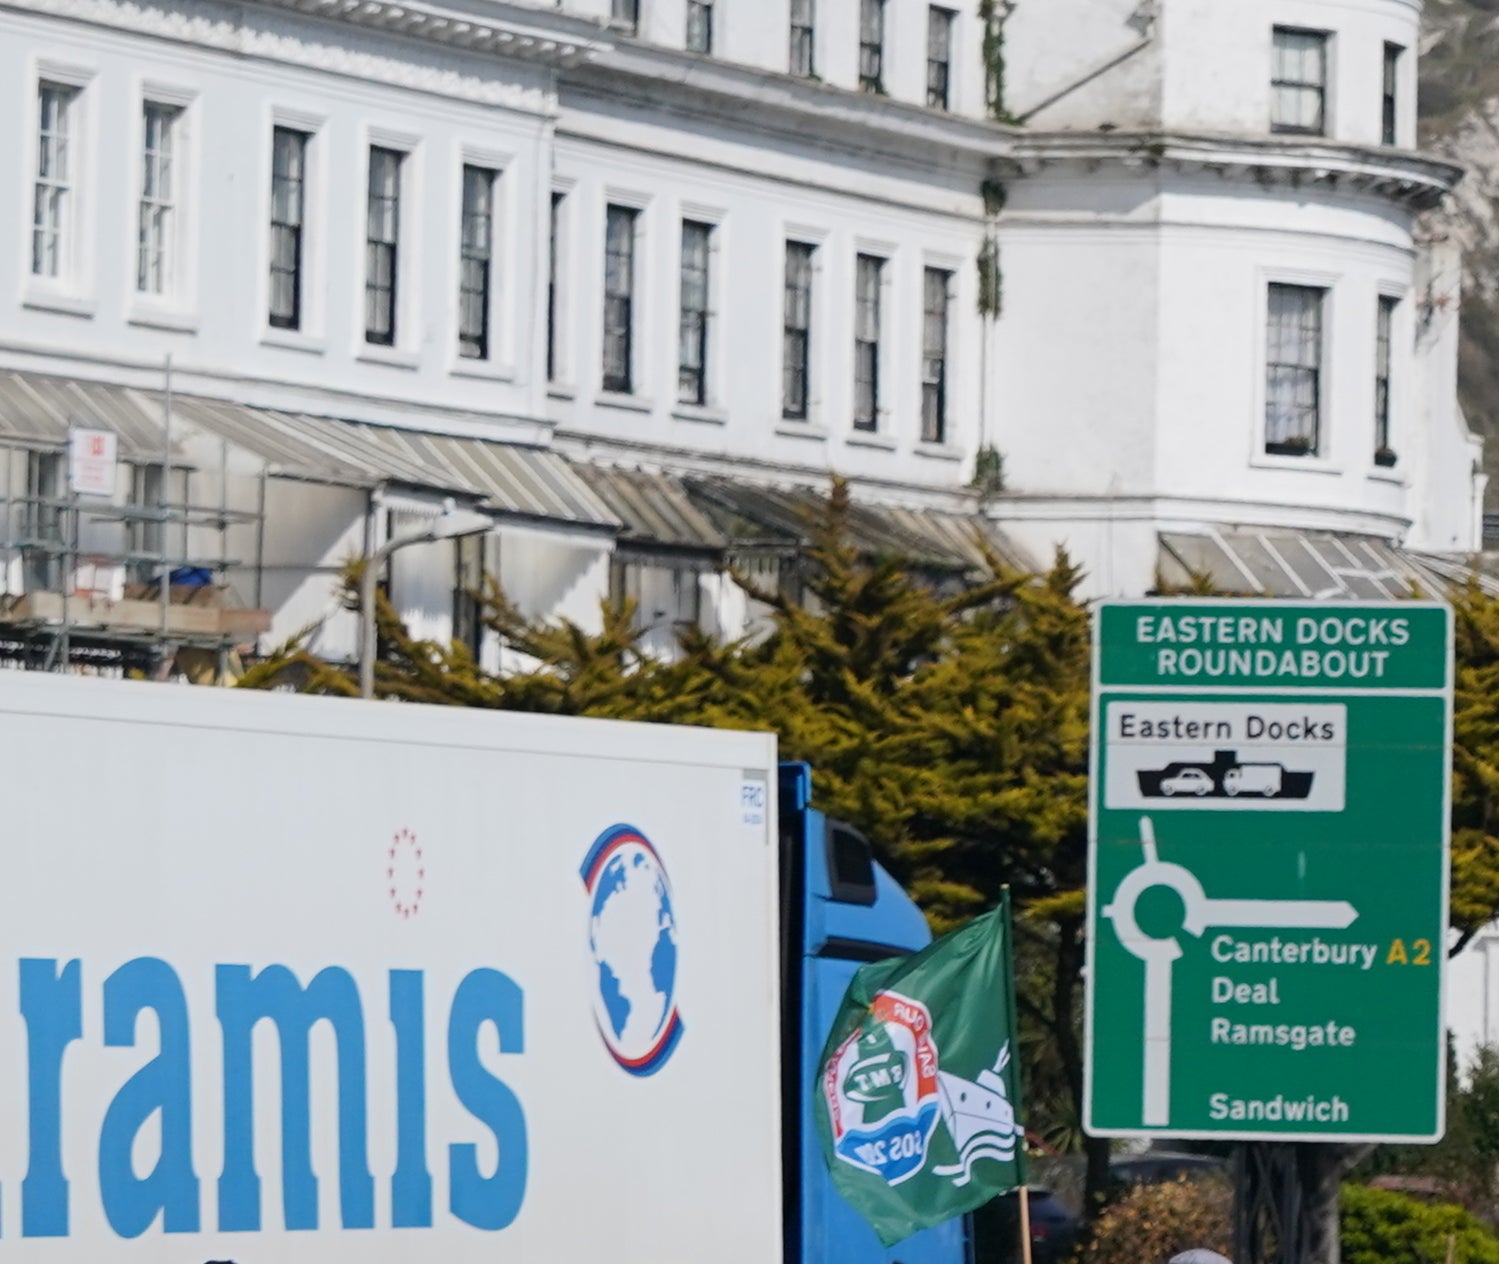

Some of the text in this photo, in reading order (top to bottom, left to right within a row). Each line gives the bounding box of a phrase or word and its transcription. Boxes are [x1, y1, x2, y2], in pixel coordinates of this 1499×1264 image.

[1137, 616, 1410, 645] EASTERN DOCKS
[1158, 648, 1390, 677] ROUNDABOUT
[1120, 714, 1336, 742] Eastern Docks
[1210, 935, 1433, 971] Canterbury A2
[1211, 976, 1281, 1005] Deal
[1211, 1017, 1356, 1050] Ramsgate
[1209, 1093, 1350, 1123] Sandwich
